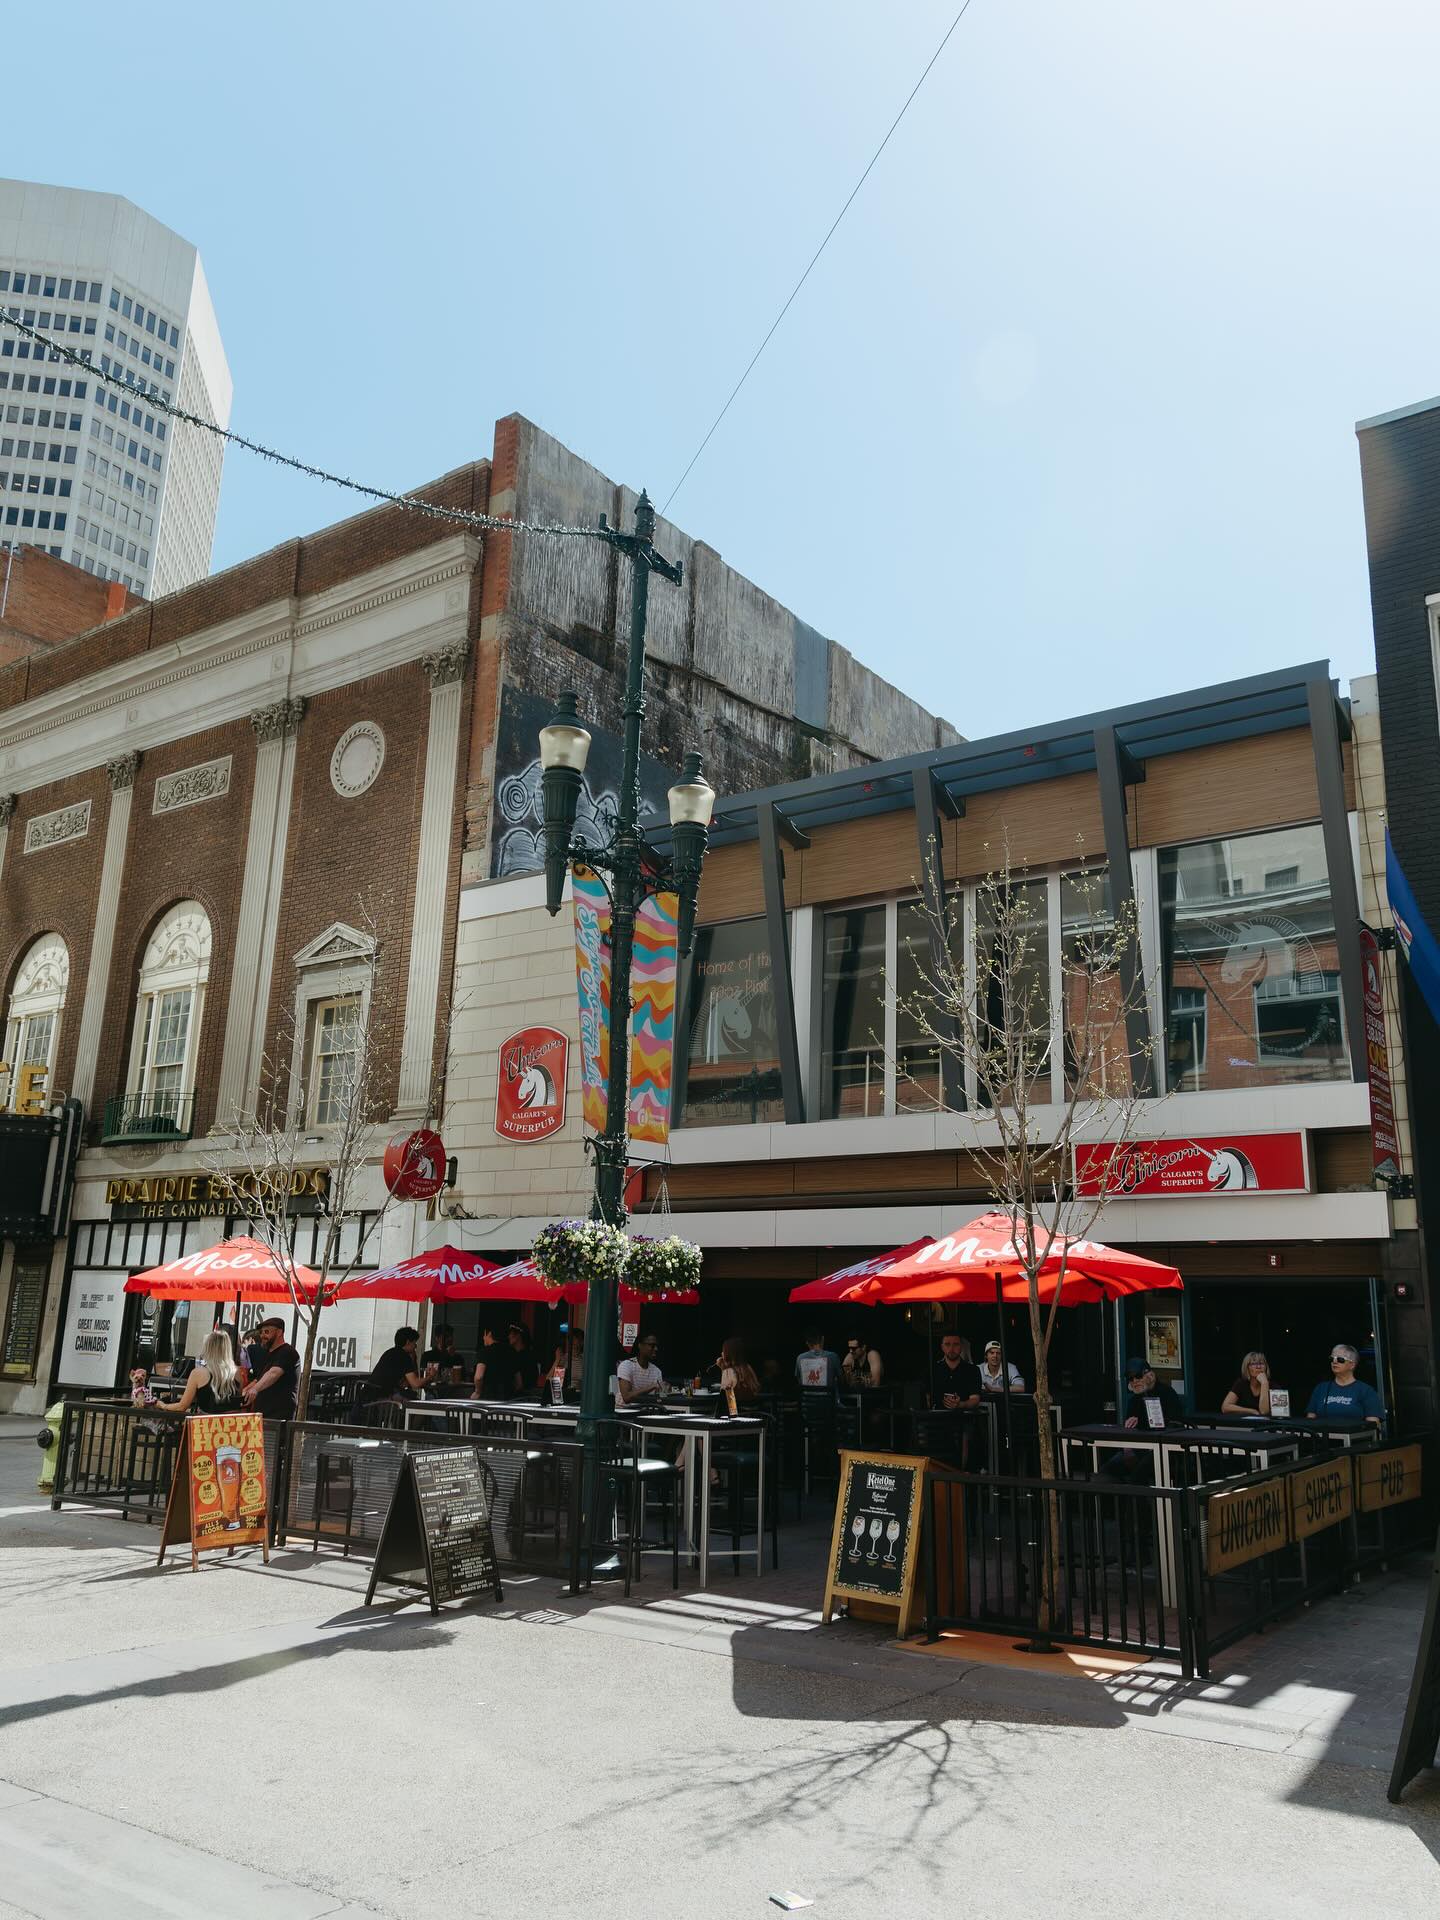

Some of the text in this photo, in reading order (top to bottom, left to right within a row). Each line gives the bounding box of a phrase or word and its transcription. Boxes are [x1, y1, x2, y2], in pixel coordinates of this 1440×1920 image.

[503, 1040, 563, 1082] Unicorn
[503, 1116, 555, 1133] SUPERPUB
[512, 1110, 547, 1120] CALGARY'S
[1113, 1146, 1202, 1194] Unicorn
[1161, 1170, 1204, 1179] CALGARY'S
[107, 1169, 324, 1203] PRAIRIE RECORDS
[1161, 1178, 1204, 1187] SUPERPUB
[142, 1200, 283, 1218] THE CANNABIS SHOP
[915, 1236, 1105, 1265] Molson
[163, 1252, 304, 1276] Molson
[8, 1316, 17, 1343] PALACE
[77, 1319, 111, 1331] GREAT MUSIC
[75, 1335, 108, 1352] CANNABIS
[316, 1336, 357, 1368] CREA
[193, 1416, 261, 1433] HAPPY
[194, 1431, 264, 1452] HOUR
[867, 1473, 896, 1486] Ketel One
[1380, 1459, 1405, 1500] PUB
[1305, 1471, 1343, 1524] SUPER
[202, 1524, 224, 1536] FLOORS
[1219, 1488, 1282, 1555] UNICORN
